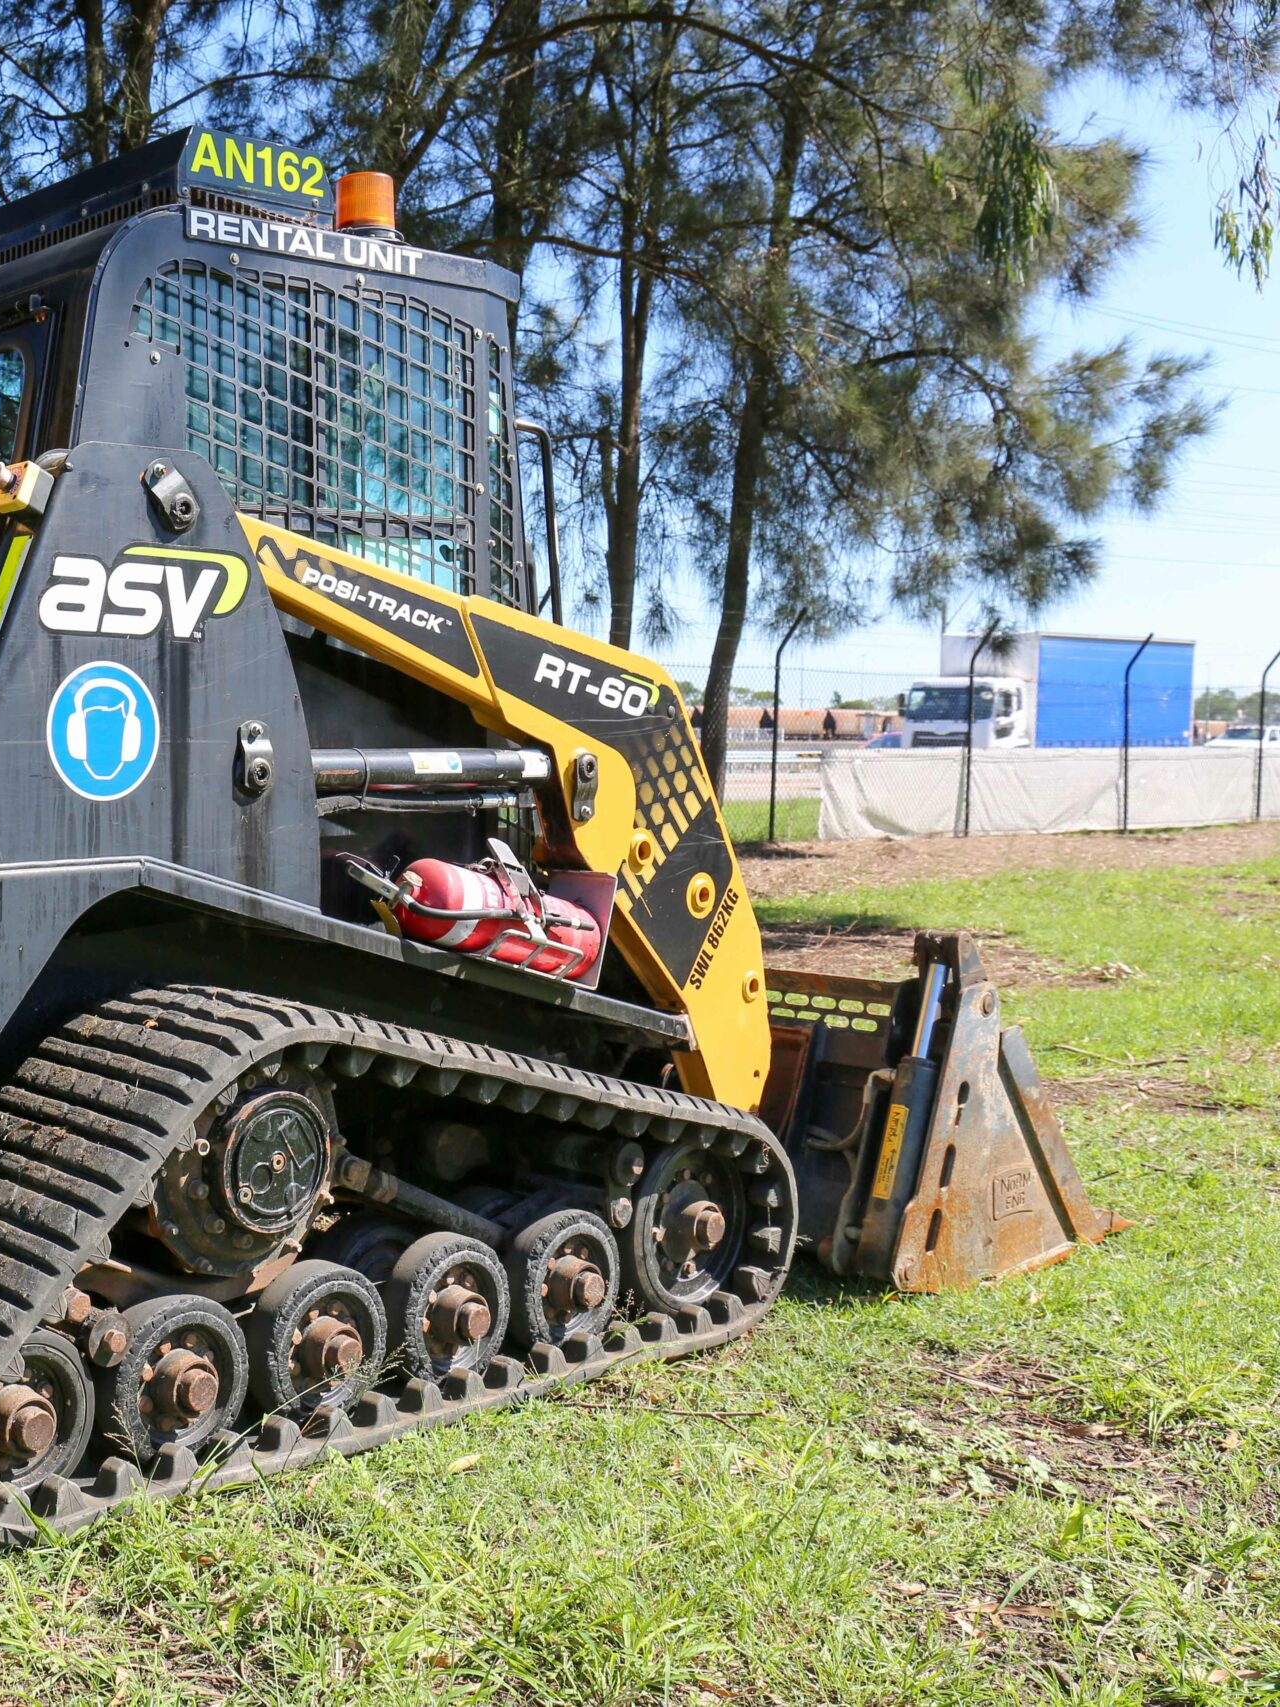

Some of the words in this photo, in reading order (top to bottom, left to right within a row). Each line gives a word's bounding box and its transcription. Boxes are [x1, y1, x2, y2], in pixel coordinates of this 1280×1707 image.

[190, 132, 324, 197] AN162
[190, 210, 335, 260] RENTAL
[344, 238, 422, 275] UNIT
[534, 653, 649, 717] RT-60
[690, 950, 713, 990] SWL
[707, 888, 739, 949] 862KG
